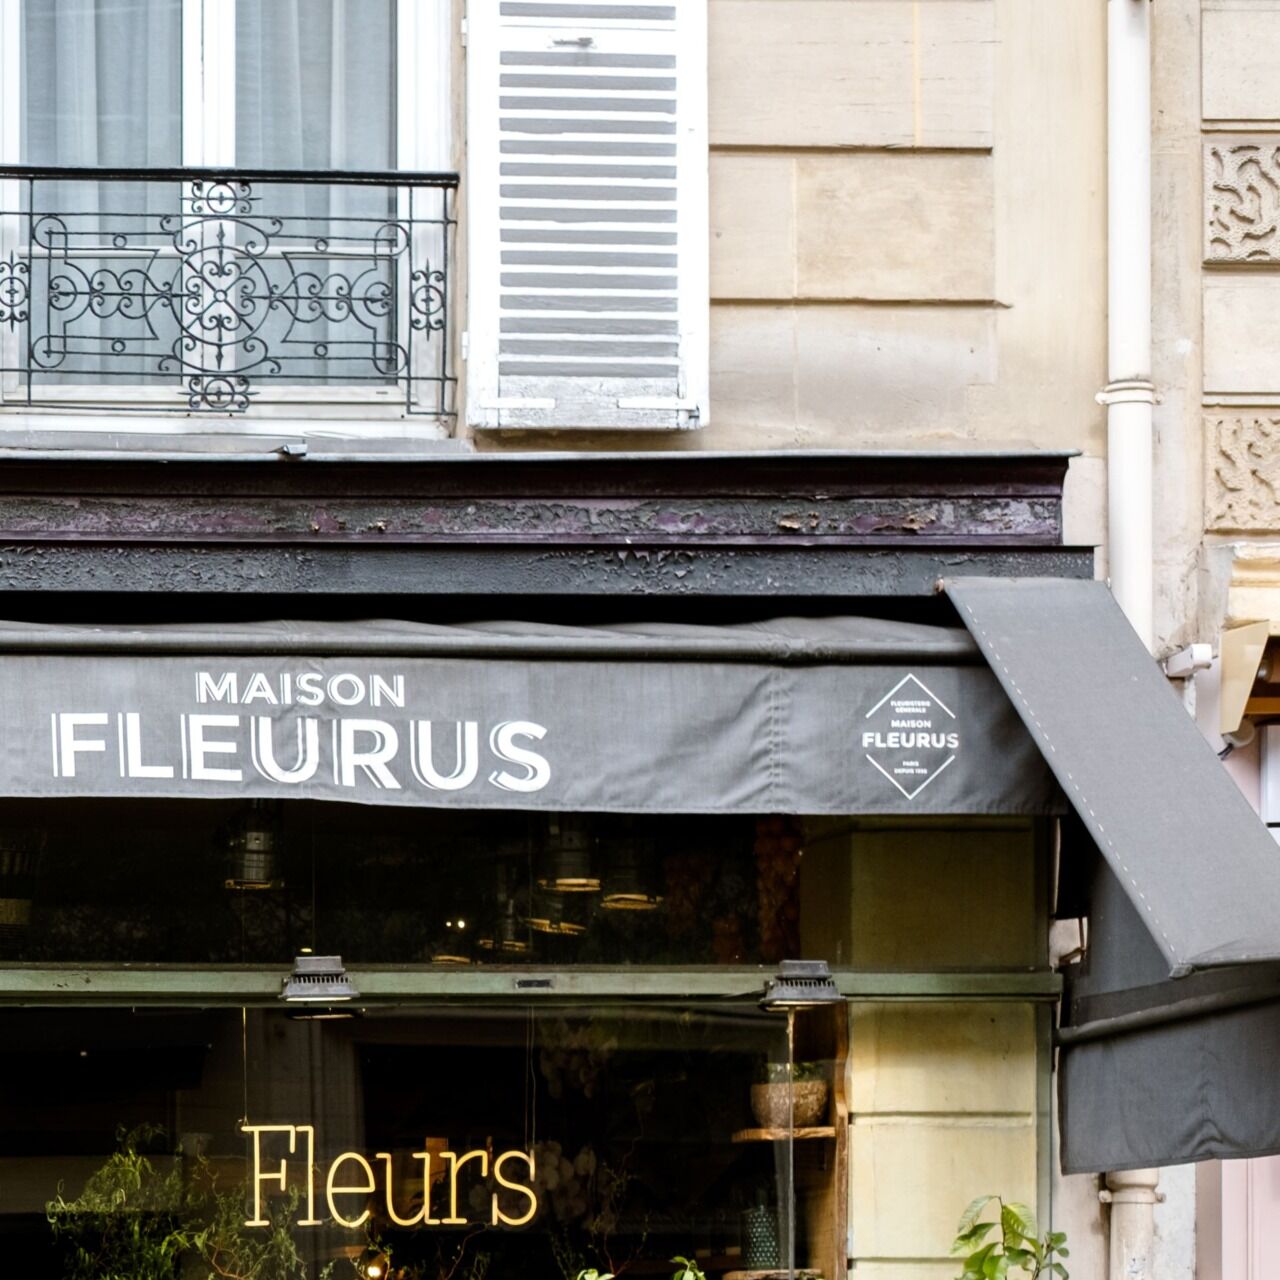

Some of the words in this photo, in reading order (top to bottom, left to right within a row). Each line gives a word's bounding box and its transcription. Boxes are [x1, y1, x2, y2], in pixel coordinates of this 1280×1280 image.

[195, 671, 406, 707] MAISON
[862, 732, 959, 748] FLEURUS
[891, 720, 931, 728] MAISON
[51, 711, 552, 793] FLEURUS
[241, 1125, 538, 1228] Fleurs
